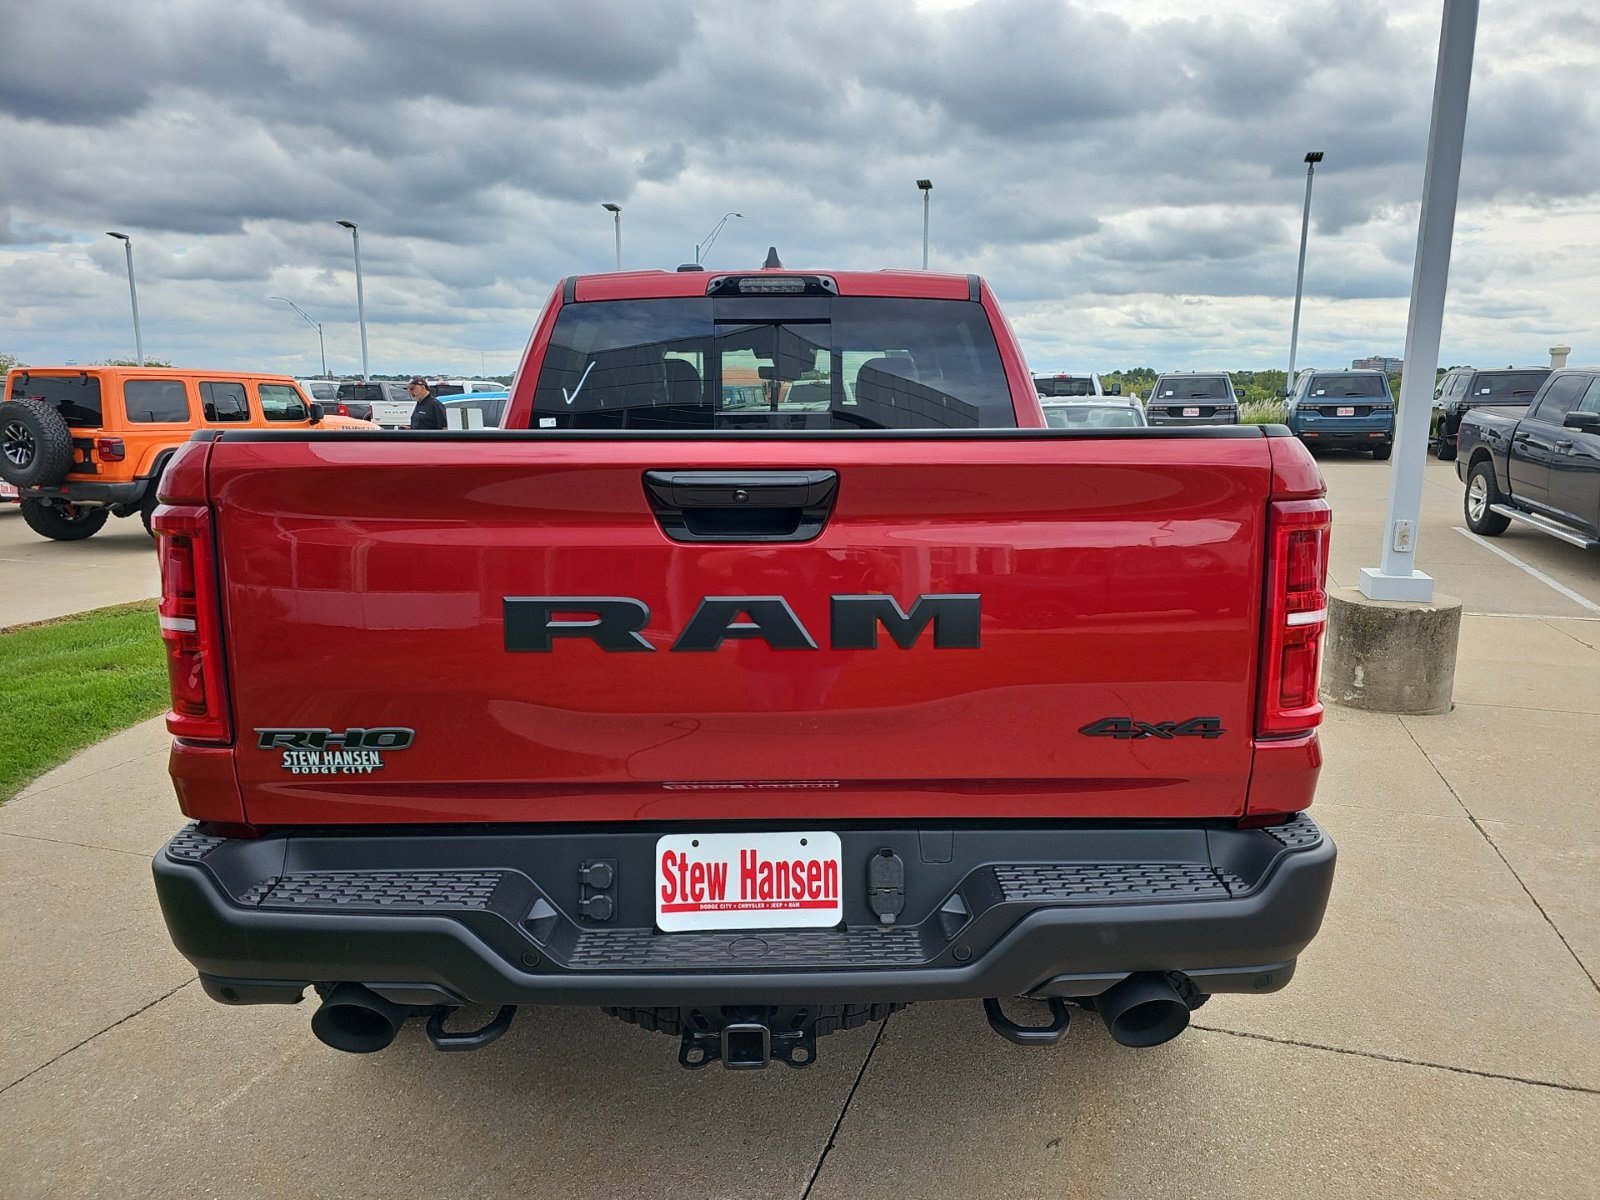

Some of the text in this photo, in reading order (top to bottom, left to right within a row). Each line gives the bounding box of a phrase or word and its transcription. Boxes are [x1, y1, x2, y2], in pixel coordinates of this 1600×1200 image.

[502, 593, 982, 652] RAM
[253, 727, 416, 751] RHO
[282, 751, 380, 766] STEW HANSEN
[291, 766, 374, 774] DODGE CITY
[661, 849, 839, 903] Stew Hansen
